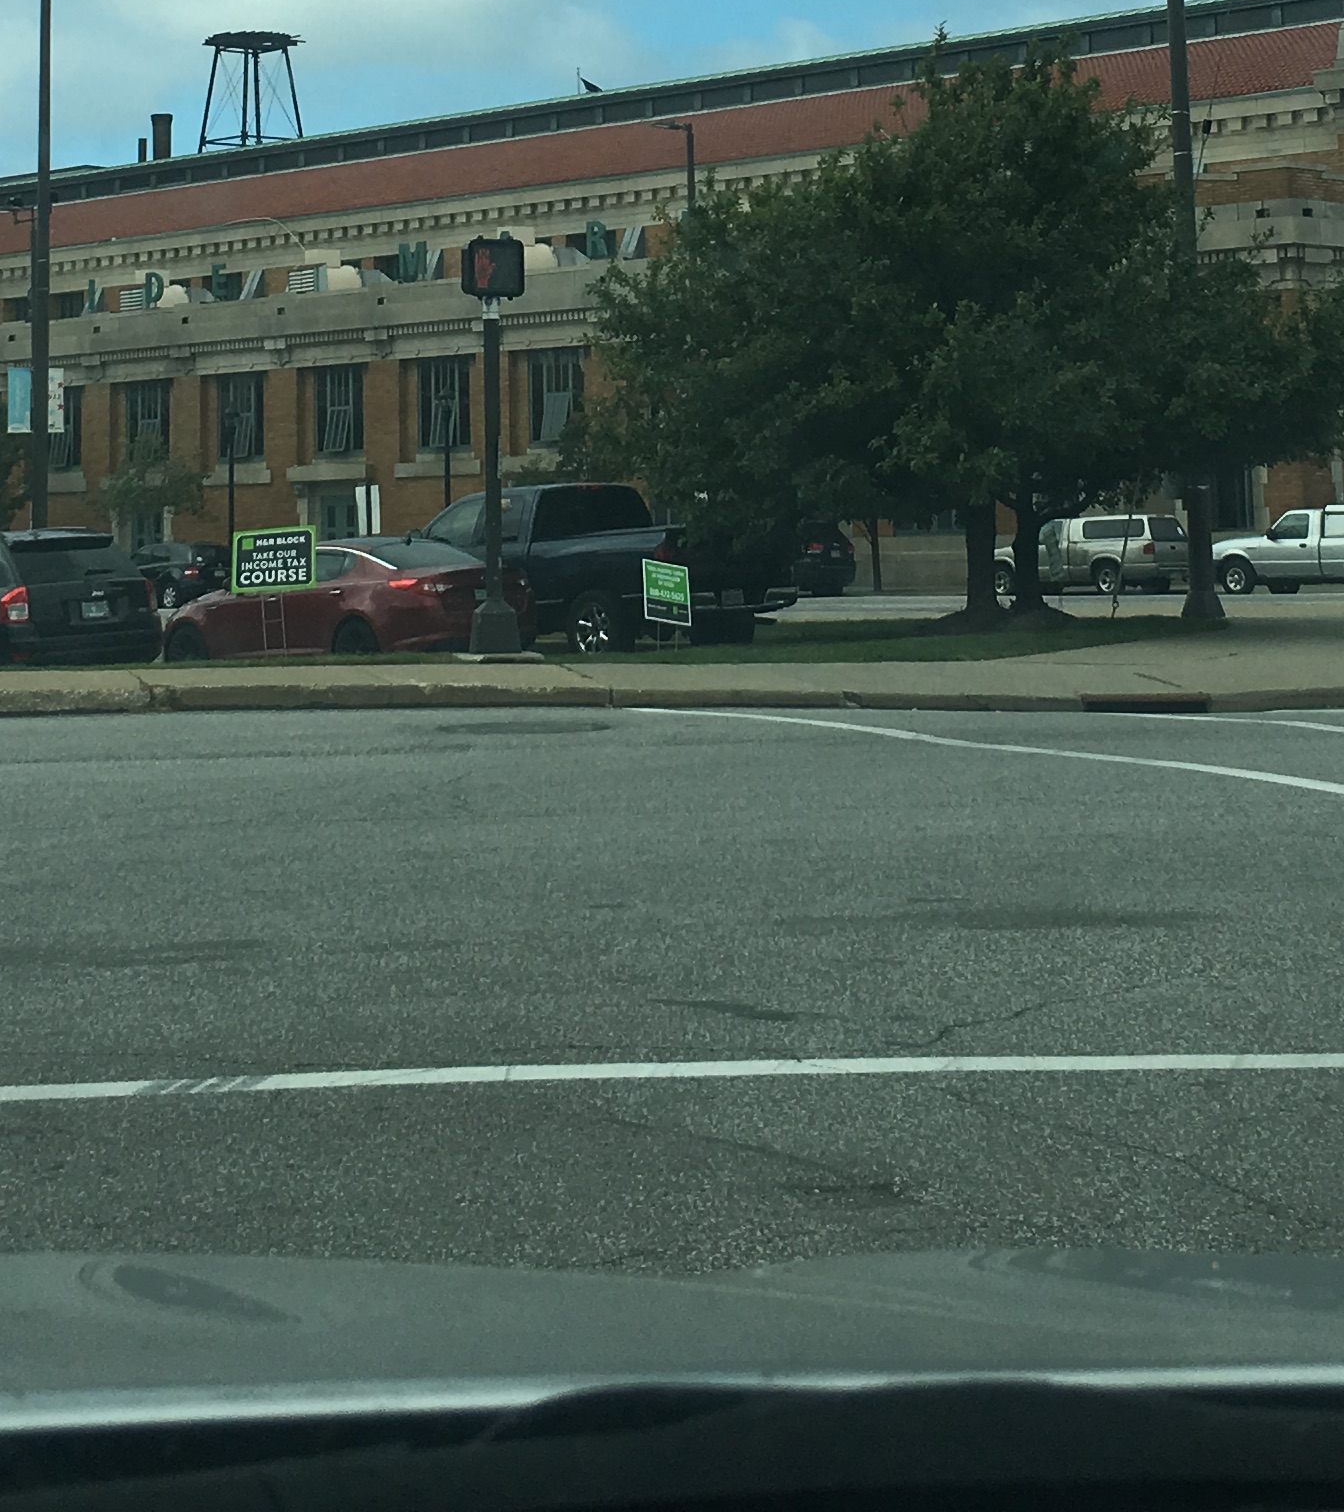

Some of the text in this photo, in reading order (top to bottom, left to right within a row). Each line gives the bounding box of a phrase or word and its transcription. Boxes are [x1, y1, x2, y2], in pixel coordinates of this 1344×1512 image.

[256, 535, 306, 546] H&R BLOCK
[252, 549, 297, 559] TAKE OUR
[241, 557, 307, 570] INCOME TAX
[240, 568, 307, 584] COURSE
